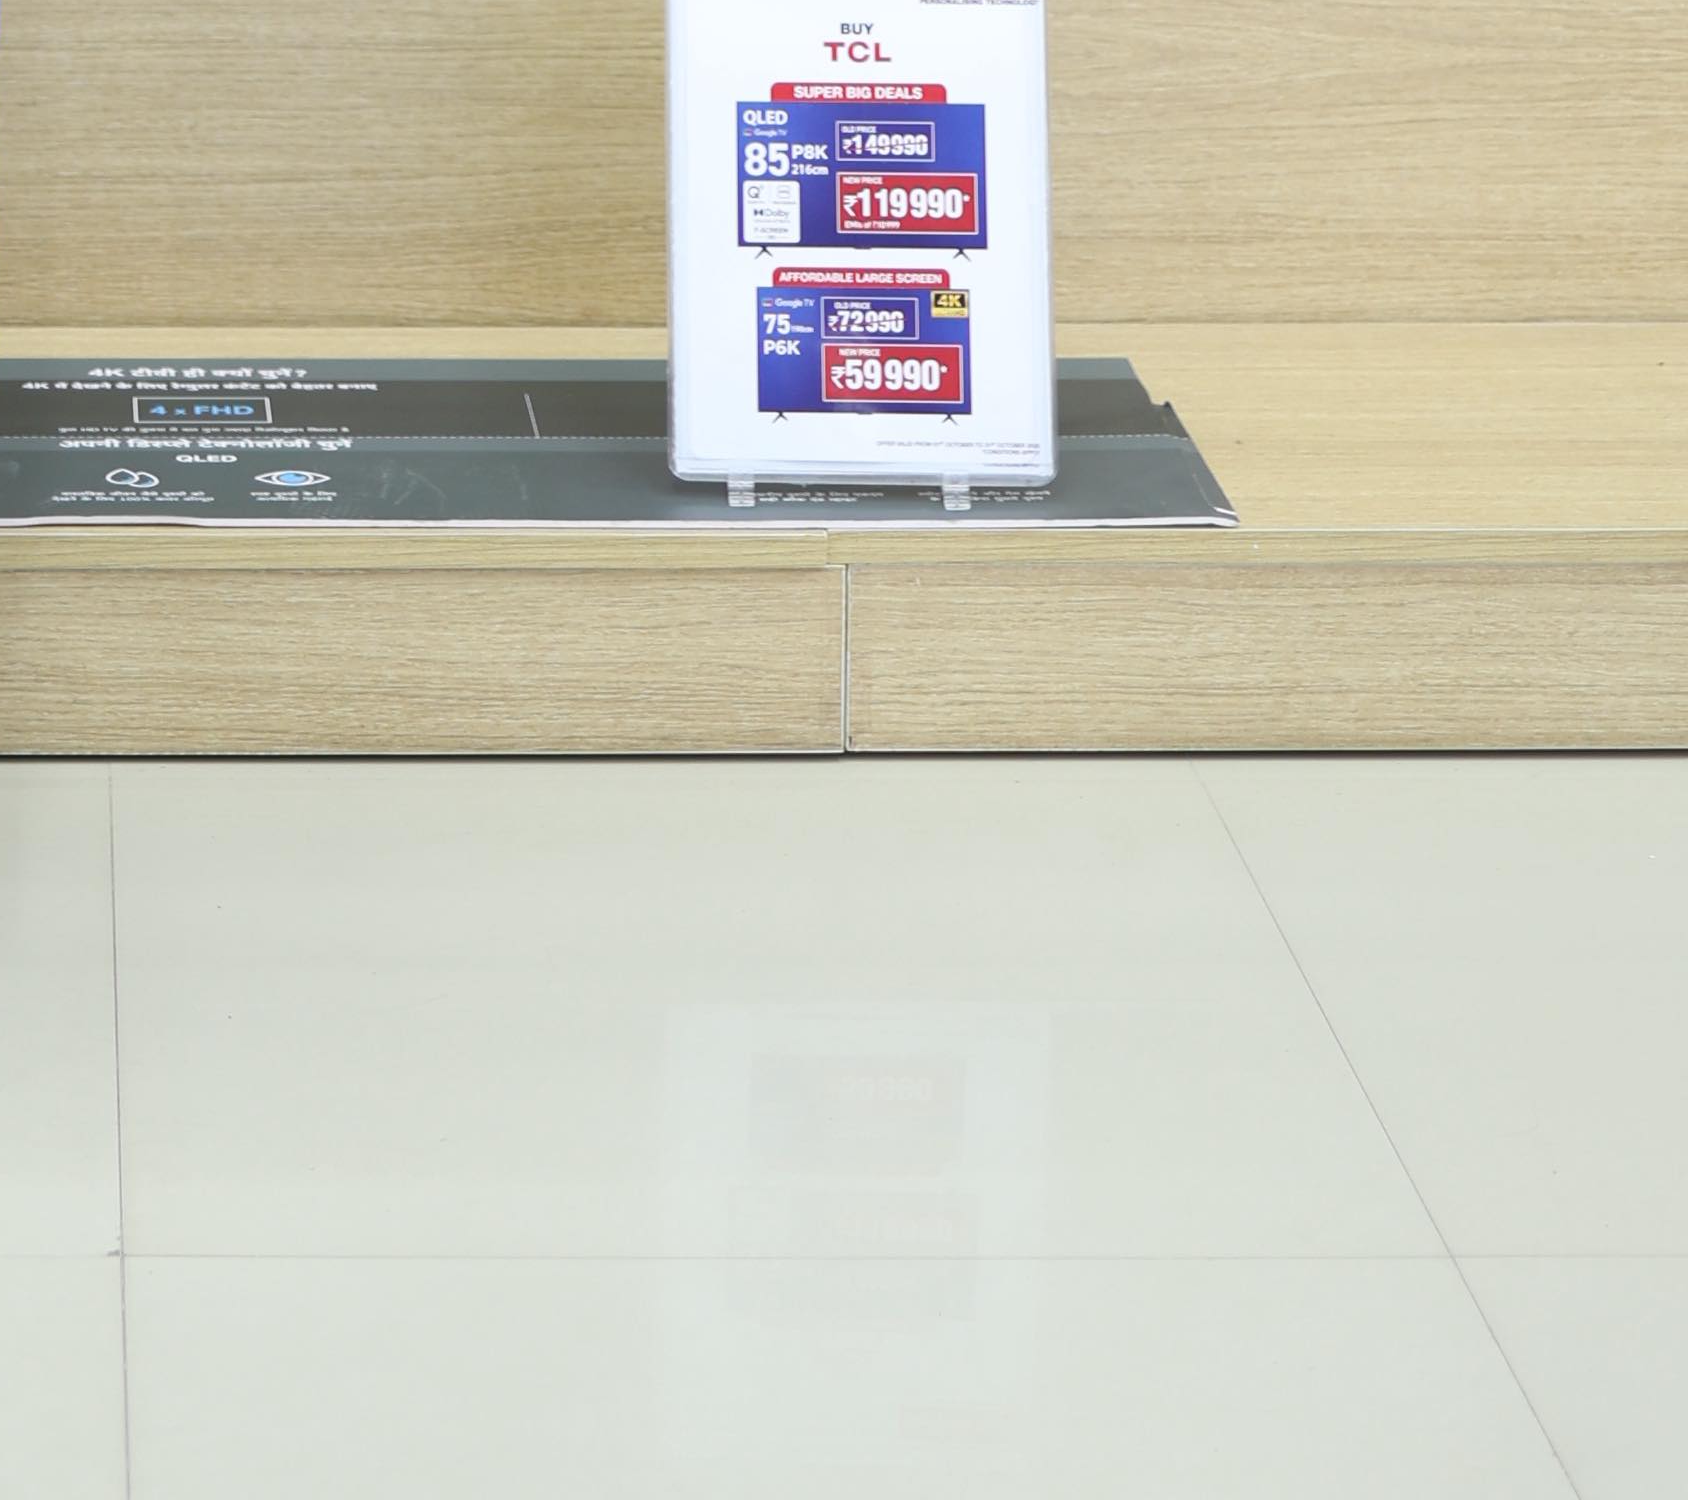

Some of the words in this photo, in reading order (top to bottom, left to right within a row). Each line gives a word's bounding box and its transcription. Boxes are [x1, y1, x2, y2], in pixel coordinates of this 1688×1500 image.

[840, 22, 874, 35] BUY
[823, 41, 892, 63] TCL
[793, 85, 843, 100] SUPER
[845, 86, 872, 99] BIG
[874, 86, 924, 101] DEALS
[743, 110, 788, 127] QLED
[744, 142, 790, 177] 85
[792, 144, 828, 160] P8K
[791, 164, 829, 175] 216cm
[778, 272, 854, 284] AFFORDABLE
[855, 273, 894, 284] LARGE
[896, 273, 943, 285] SCREEN
[775, 298, 803, 309] Google
[936, 294, 963, 308] 4K
[763, 313, 791, 335] 75
[763, 340, 801, 355] P6K
[88, 367, 125, 377] 4K
[129, 366, 177, 378] टीवी
[181, 366, 205, 378] ही
[21, 381, 50, 390] 4K
[149, 404, 168, 416] 4
[193, 404, 255, 416] FHD
[58, 437, 121, 449] अपनी
[175, 453, 238, 463] QLED
